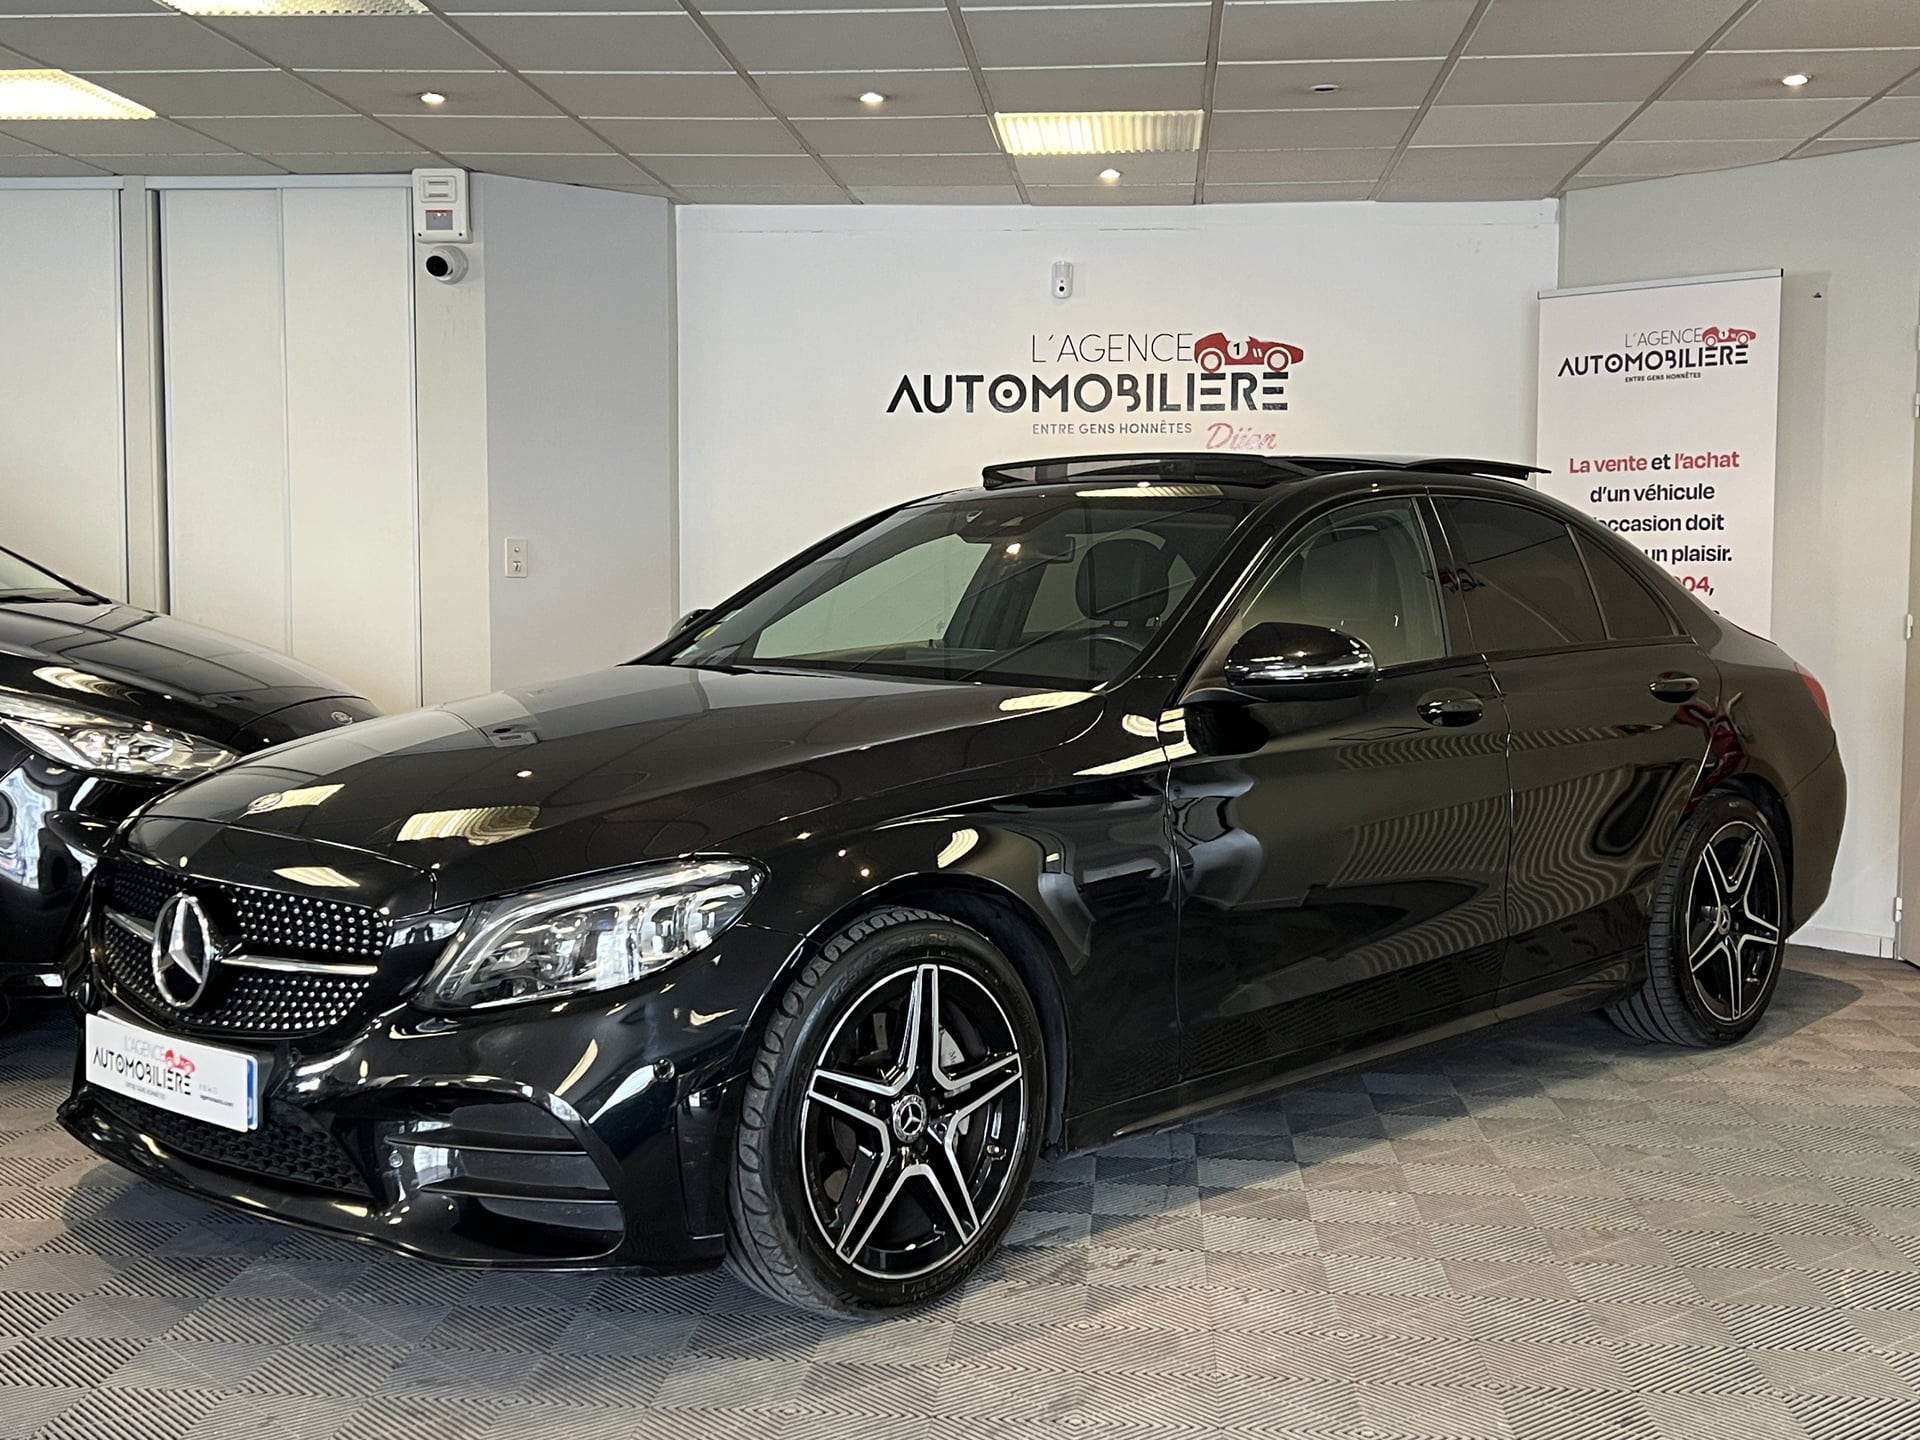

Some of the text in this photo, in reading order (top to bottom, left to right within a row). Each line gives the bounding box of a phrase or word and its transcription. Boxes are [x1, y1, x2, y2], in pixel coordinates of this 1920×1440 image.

[1032, 333, 1193, 363] L'AGENCE
[1625, 328, 1702, 348] L'AGENCE
[1233, 342, 1241, 356] 1
[1624, 375, 1646, 383] ENTRE
[1646, 373, 1665, 382] GENS
[1032, 420, 1193, 435] ENTRE GENS HONNÊTES
[1569, 451, 1740, 474] La vente et l'achat
[1590, 483, 1716, 503] d'un véhicule
[1685, 514, 1725, 532] doit
[1672, 545, 1733, 565] plaisir.
